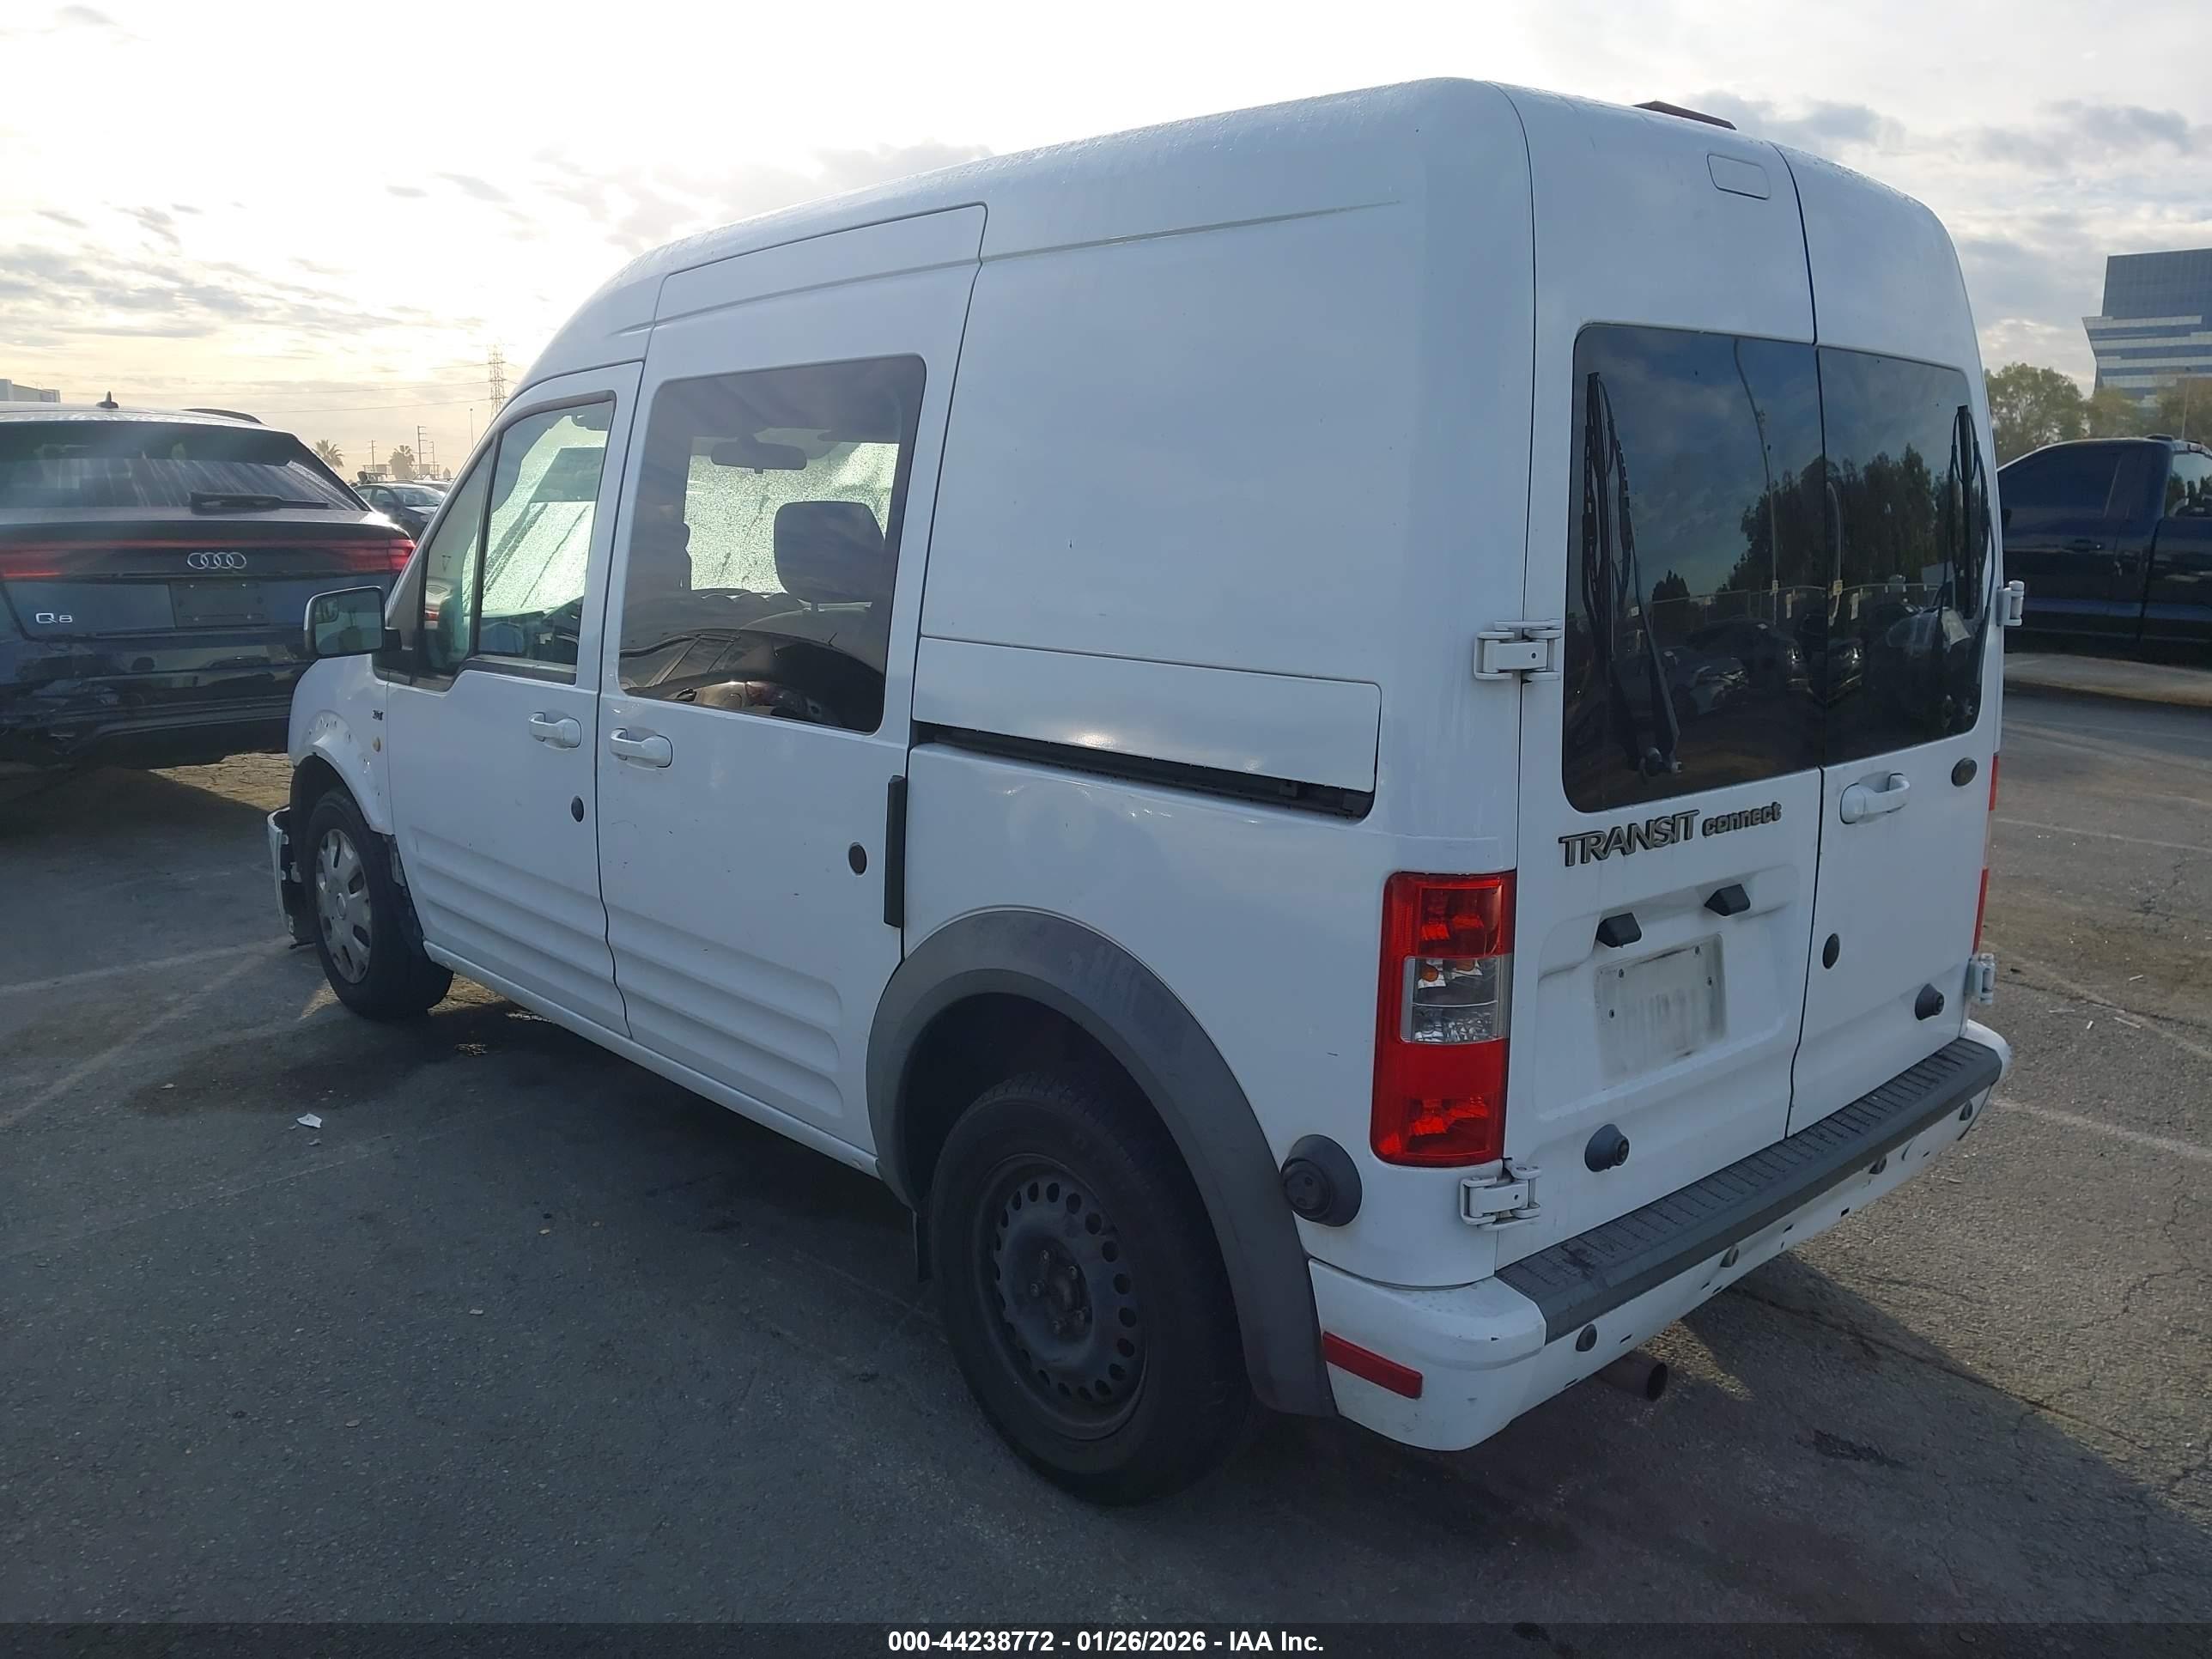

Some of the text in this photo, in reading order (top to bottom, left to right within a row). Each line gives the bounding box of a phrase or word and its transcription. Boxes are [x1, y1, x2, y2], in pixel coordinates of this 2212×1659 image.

[35, 612, 73, 624] Q8
[1559, 801, 1783, 867] TRANSIT connect
